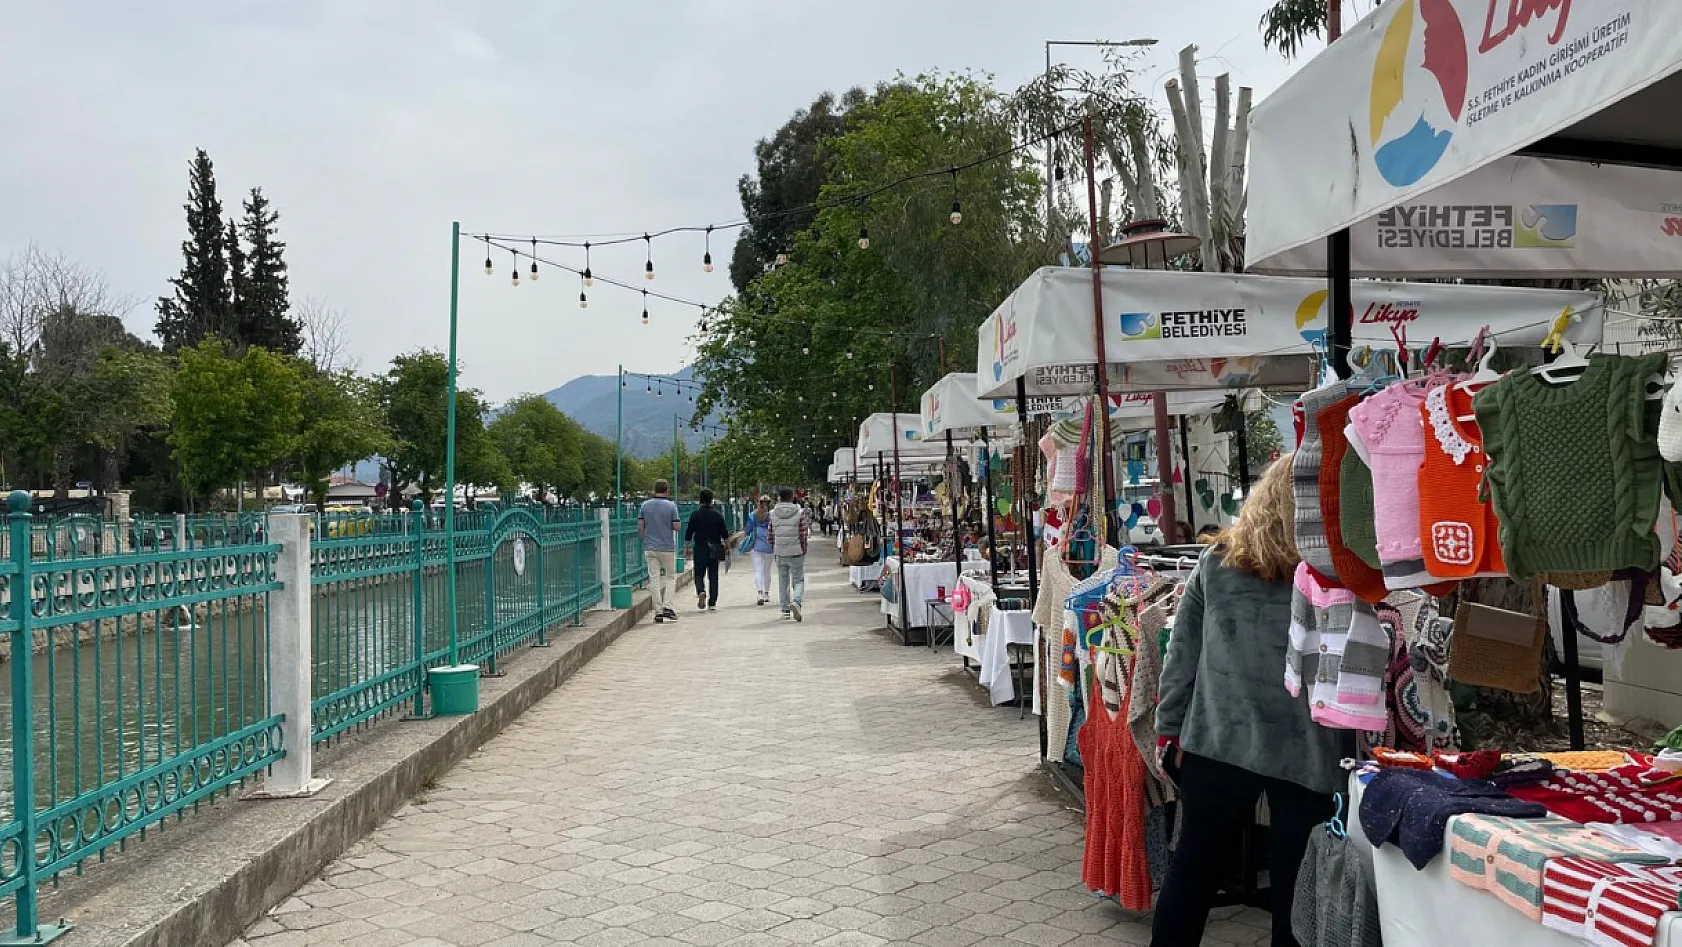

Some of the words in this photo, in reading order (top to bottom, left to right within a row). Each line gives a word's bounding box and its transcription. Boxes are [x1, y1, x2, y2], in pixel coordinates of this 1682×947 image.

[1466, 100, 1499, 127] İŞLETME
[1501, 93, 1512, 108] VE
[1514, 68, 1561, 102] KALKINMA
[1564, 27, 1629, 77] KOOPERATİFİ
[1467, 96, 1481, 111] S.S.
[1483, 75, 1515, 102] FETHİYE
[1518, 58, 1546, 84] KADIN
[1549, 31, 1589, 67] GİRİŞİMİ
[1592, 12, 1631, 44] ÜRETİM
[1359, 301, 1420, 331] Likya
